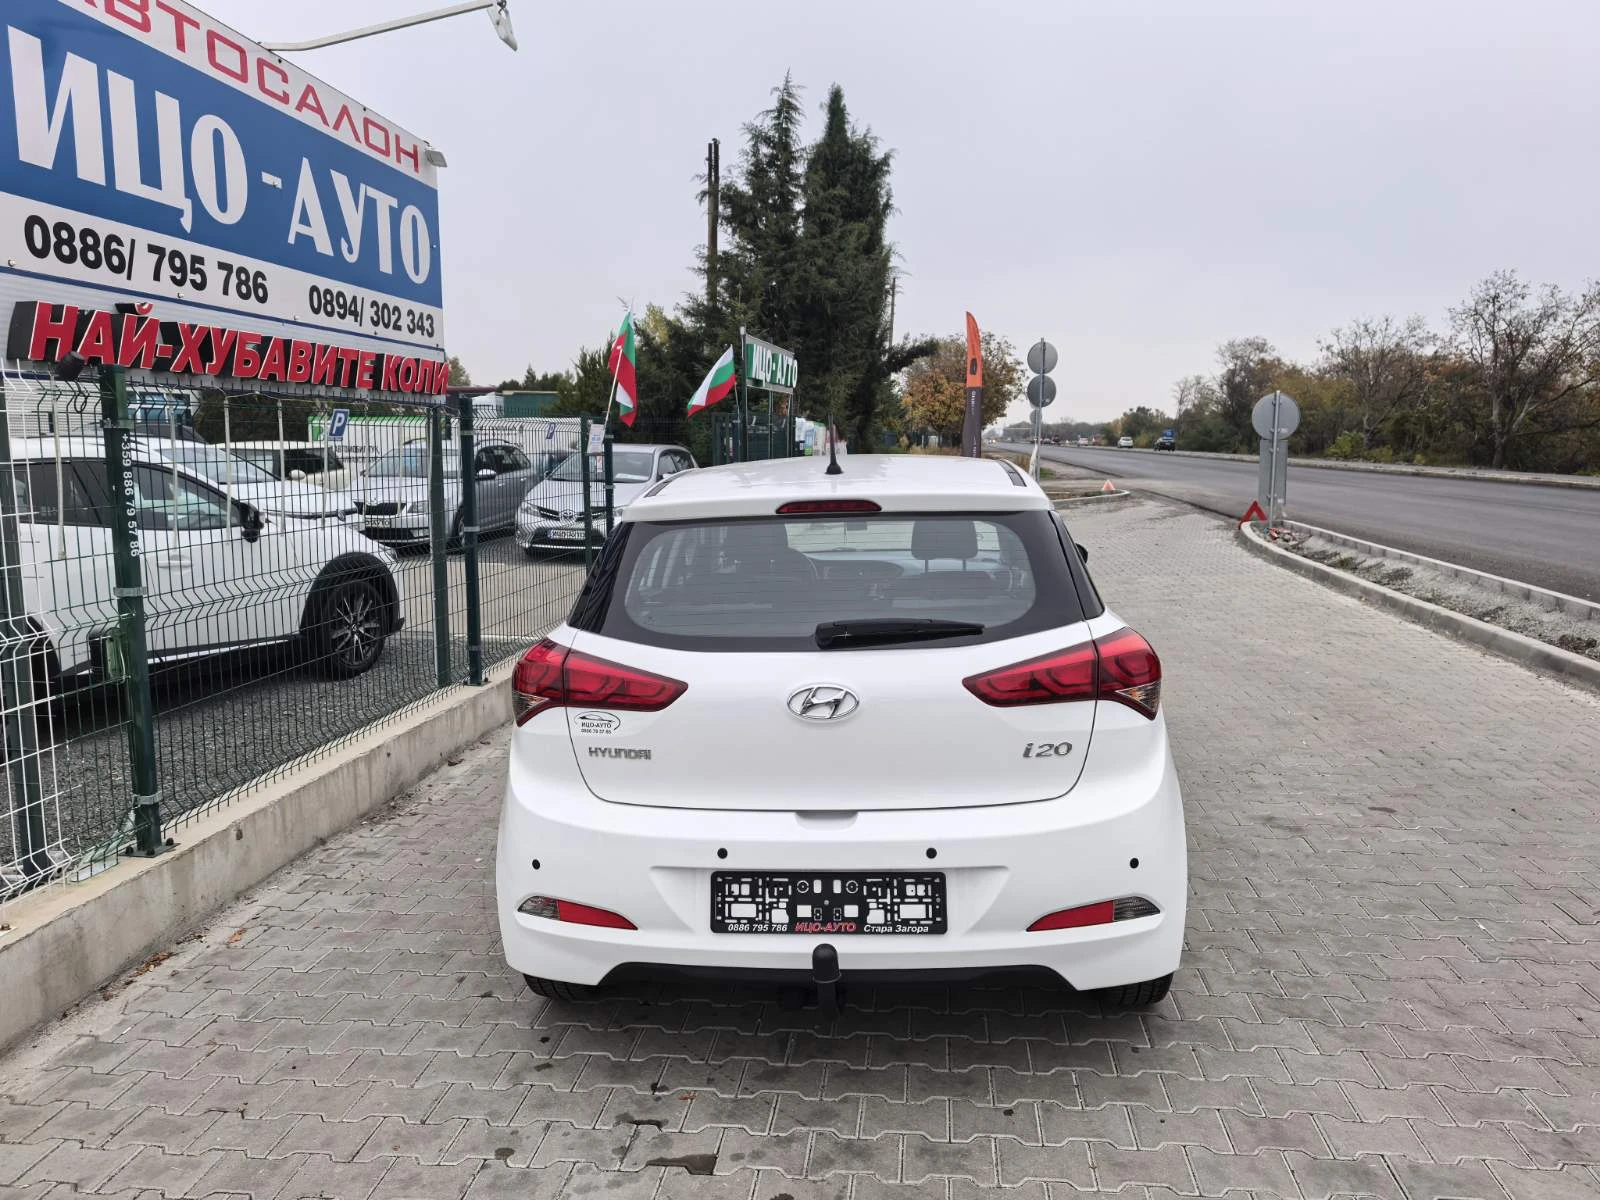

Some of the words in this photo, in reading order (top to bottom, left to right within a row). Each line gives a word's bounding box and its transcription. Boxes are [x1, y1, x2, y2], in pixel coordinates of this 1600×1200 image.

[24, 214, 136, 281] 0886/
[147, 243, 208, 292] 795
[217, 261, 269, 304] 786
[370, 300, 402, 331] 302
[407, 309, 435, 338] 343
[27, 300, 377, 390] НАЙ-ХУБАВИТЕ
[381, 352, 449, 395] КОЛИ
[752, 343, 798, 389] ИЦО-АУТО
[121, 433, 132, 467] +359
[123, 471, 134, 496] 886
[126, 499, 136, 517] 79
[127, 520, 138, 536] 57
[129, 540, 140, 557] 86
[588, 747, 652, 760] HYUNDAI
[1022, 741, 1073, 758] i20
[728, 923, 750, 932] 0886
[752, 923, 769, 932] 795
[771, 923, 788, 932] 786
[795, 921, 857, 933] ИЦО-АУТО
[863, 924, 893, 933] Стара
[895, 924, 929, 933] Загора
